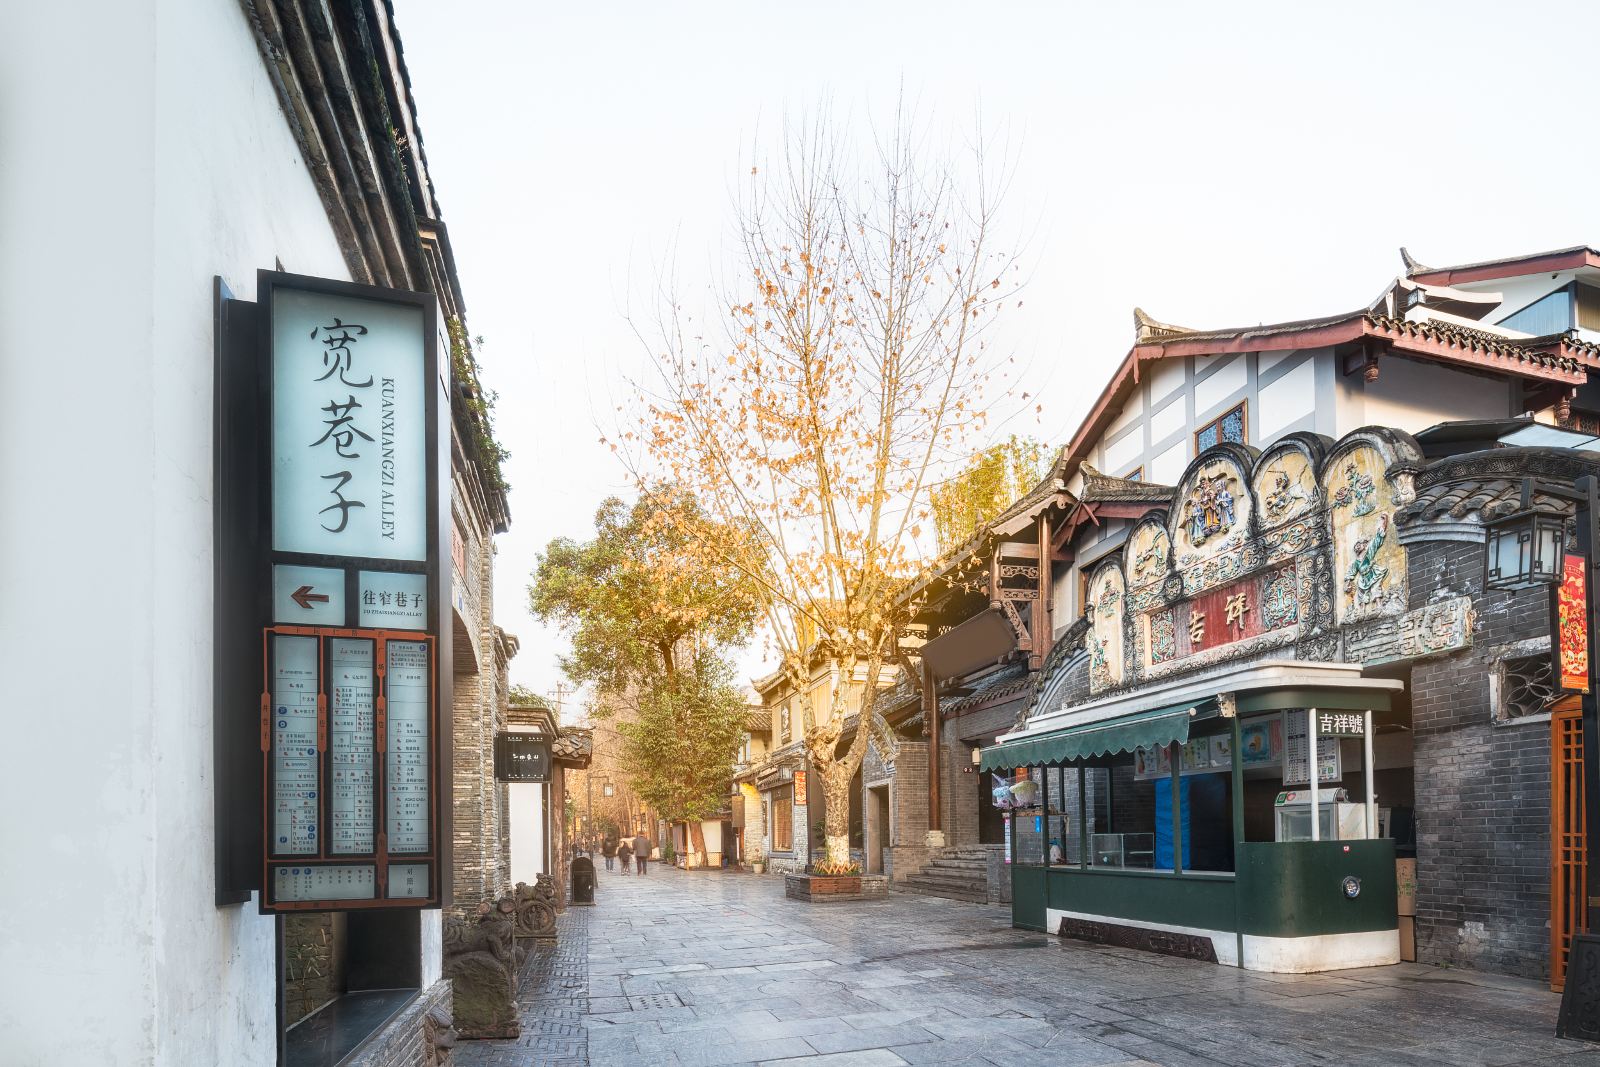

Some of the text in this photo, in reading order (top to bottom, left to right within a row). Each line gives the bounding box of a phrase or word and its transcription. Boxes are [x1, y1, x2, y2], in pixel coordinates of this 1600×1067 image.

[309, 317, 375, 534] 宽巷子
[381, 376, 395, 541] KUANXIANGZI ALLEY
[363, 589, 423, 608] 往窄巷子
[1189, 592, 1250, 644] 吉祥
[1319, 713, 1364, 734] 吉祥號
